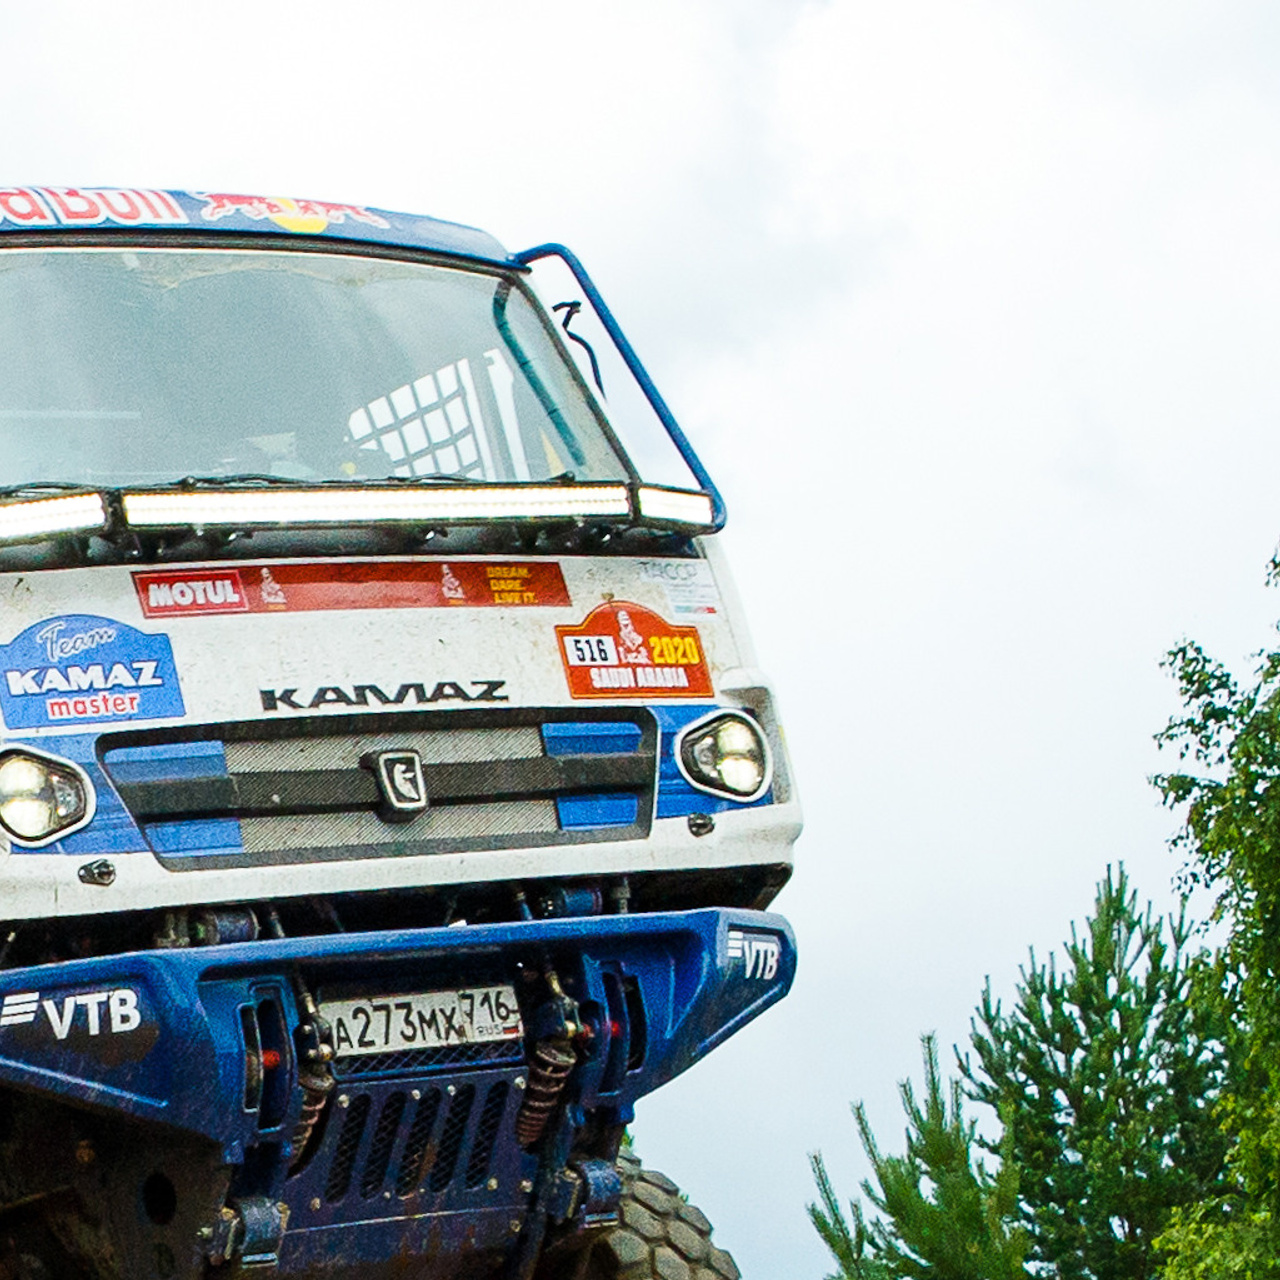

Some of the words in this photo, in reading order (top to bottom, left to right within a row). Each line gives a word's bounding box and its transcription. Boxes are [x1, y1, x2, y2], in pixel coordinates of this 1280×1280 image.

[149, 579, 240, 607] MOTUL
[39, 621, 116, 661] Team
[574, 638, 609, 663] 516
[648, 636, 701, 665] 2020
[6, 661, 163, 697] KAMAZ
[590, 667, 636, 689] SAUDI
[49, 693, 138, 718] master
[260, 680, 509, 712] KAMAZ
[743, 940, 779, 980] VTB
[42, 989, 141, 1040] VTB
